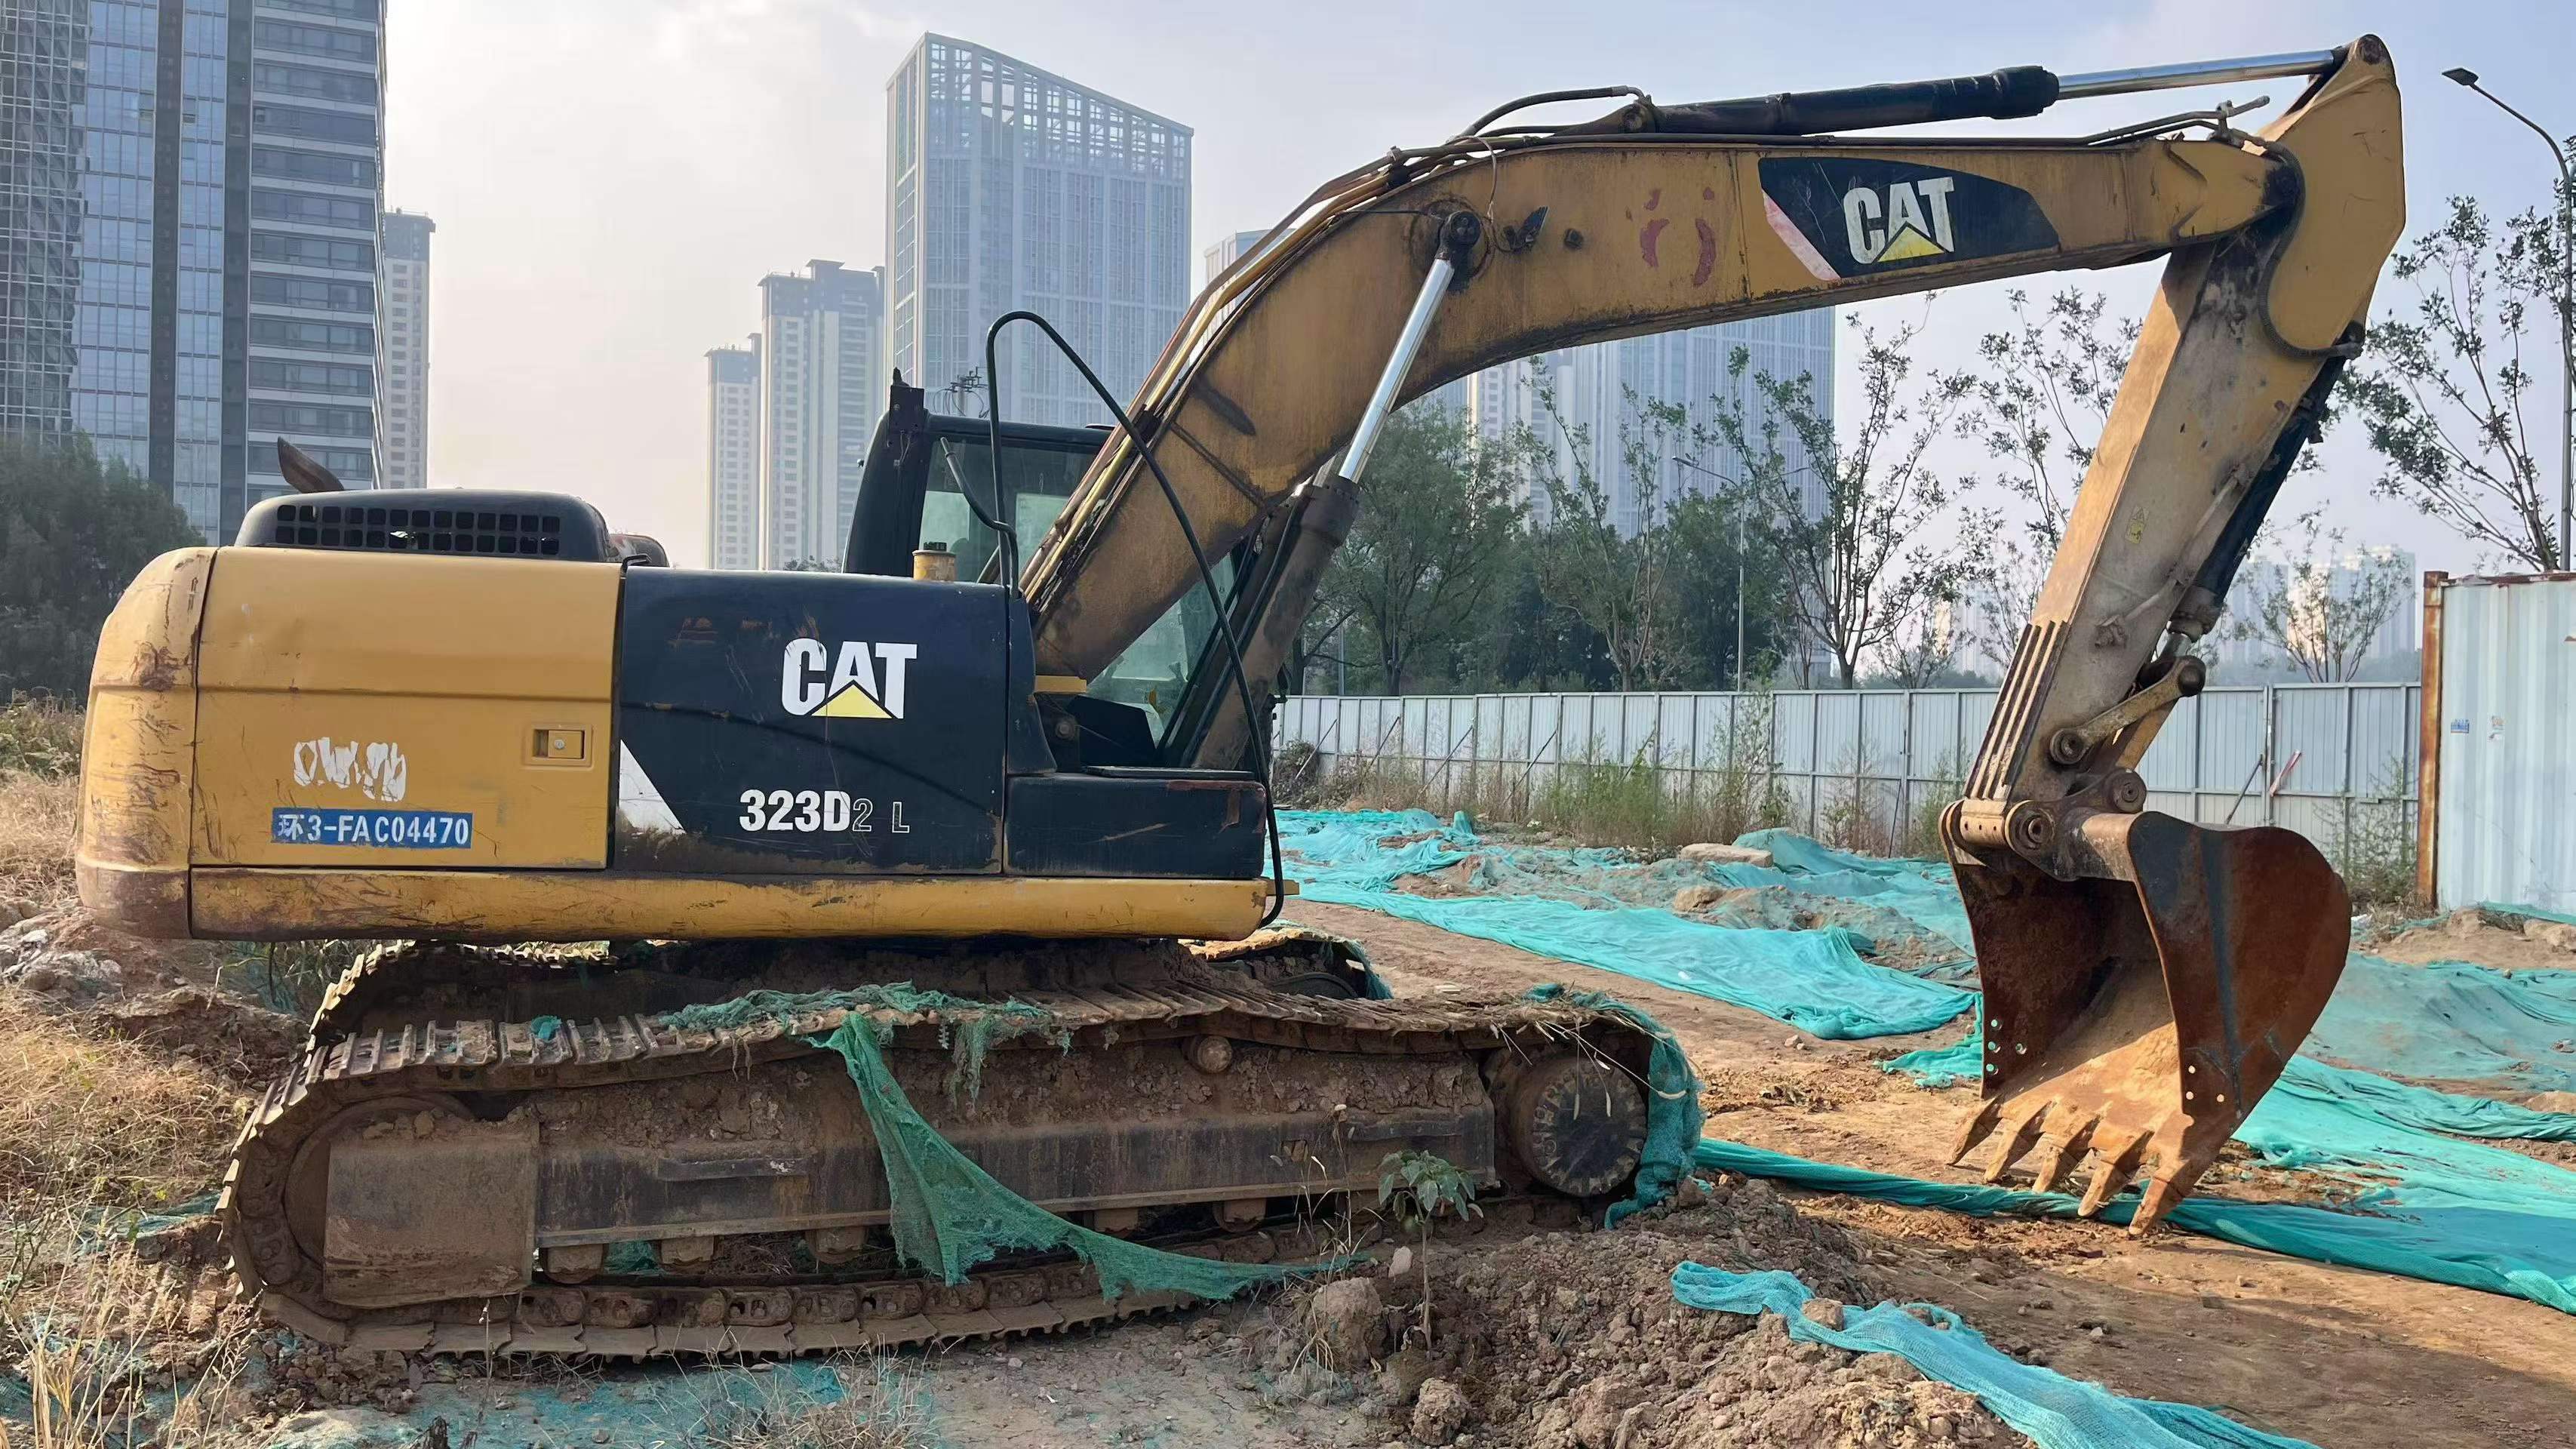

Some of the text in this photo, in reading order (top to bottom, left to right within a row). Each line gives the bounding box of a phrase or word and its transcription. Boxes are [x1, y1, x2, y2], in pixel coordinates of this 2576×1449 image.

[1843, 176, 1955, 265] CAT
[782, 638, 918, 719] CAT
[739, 789, 910, 833] 323D2 L
